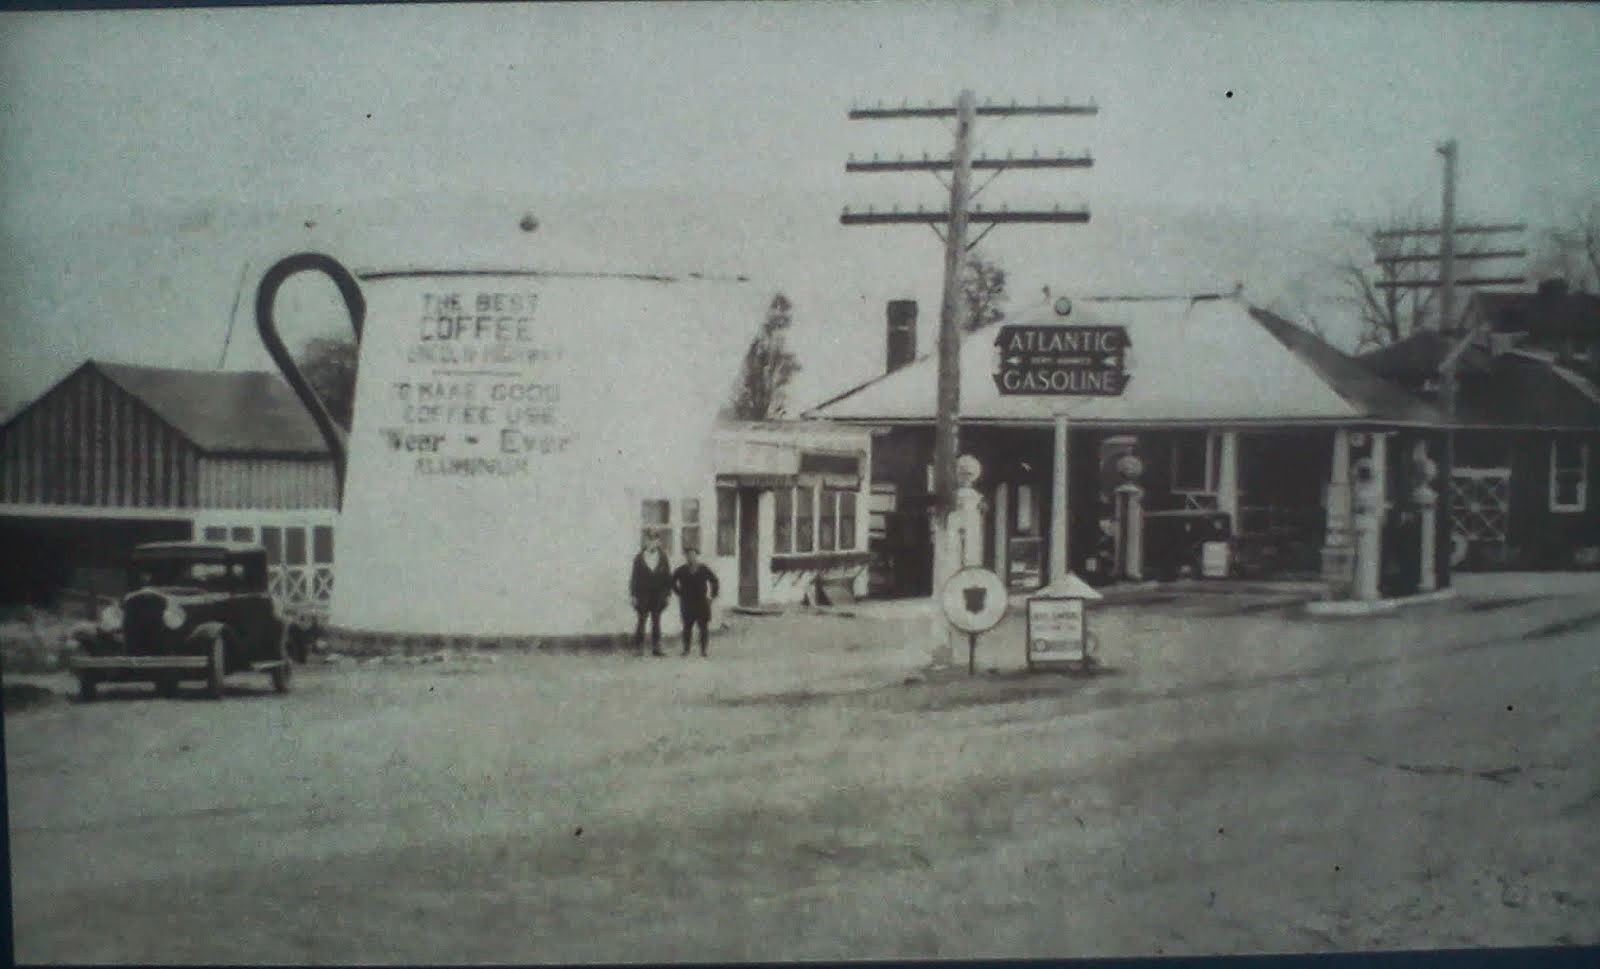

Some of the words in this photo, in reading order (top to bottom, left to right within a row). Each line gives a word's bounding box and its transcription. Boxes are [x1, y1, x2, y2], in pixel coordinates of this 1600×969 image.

[423, 292, 461, 313] THE
[475, 292, 537, 312] BEST
[421, 315, 534, 341] COFFEE
[1009, 330, 1117, 351] ATLANTIC
[1003, 370, 1116, 391] GASOLINE
